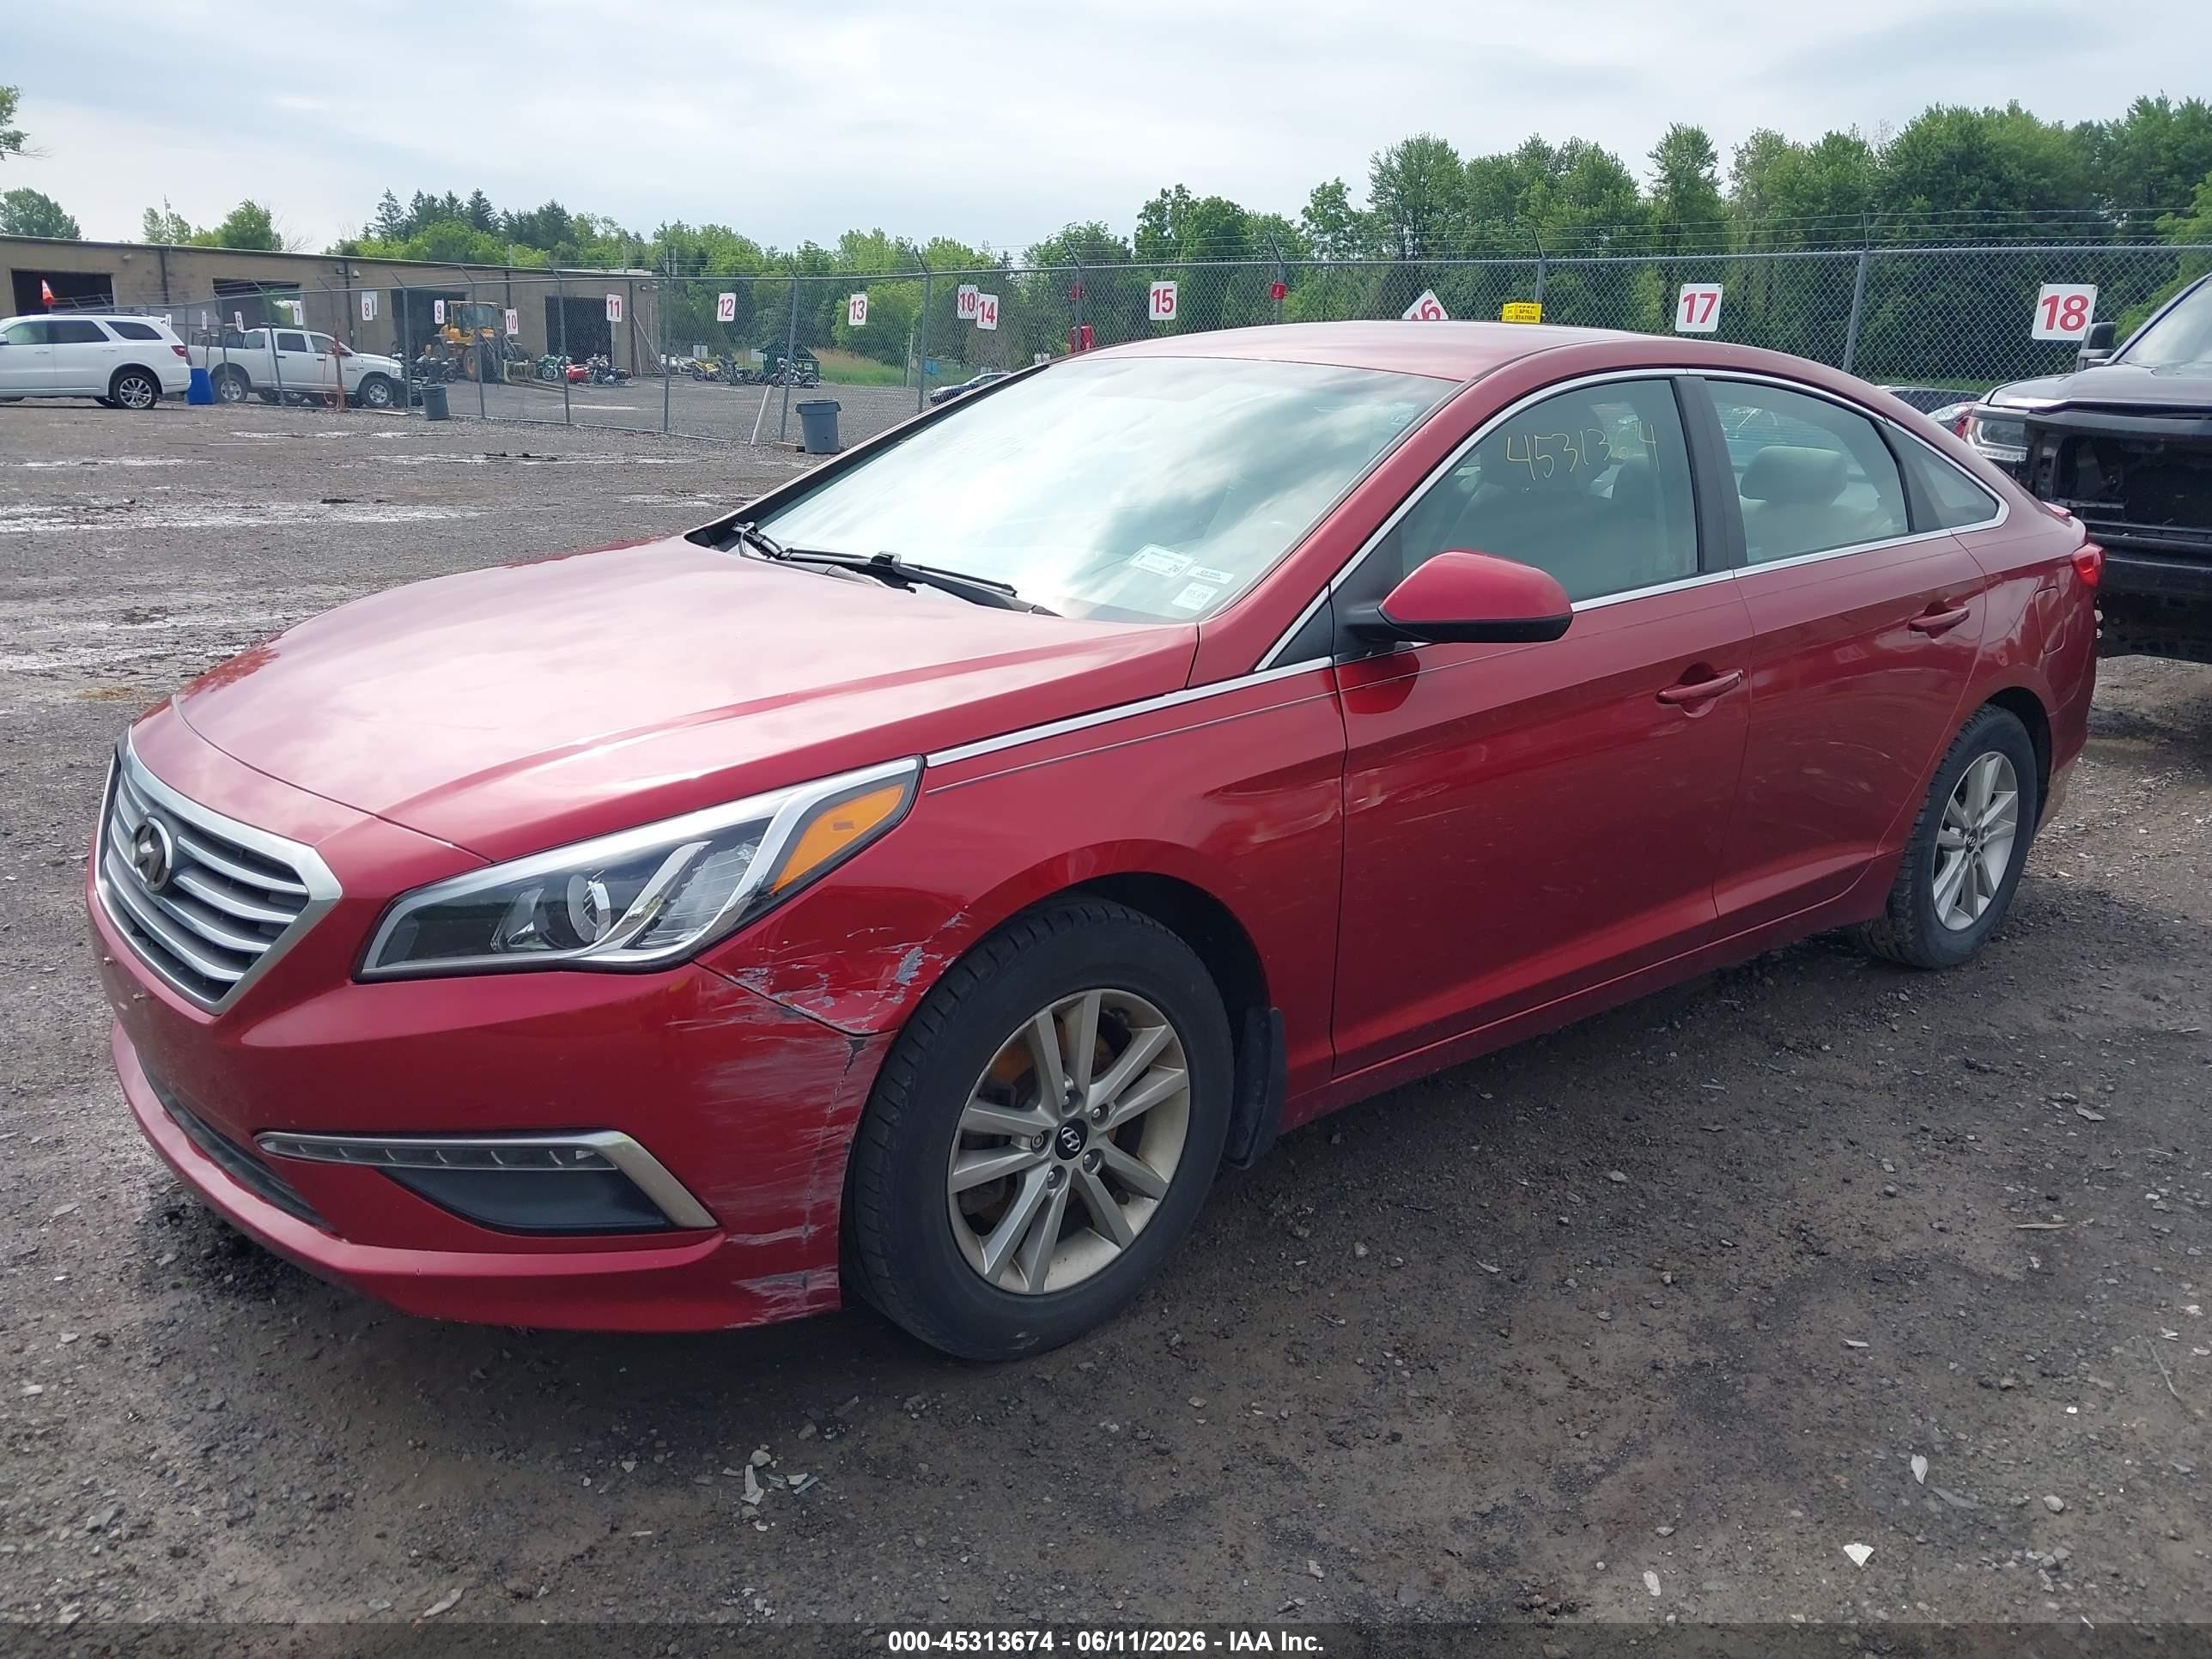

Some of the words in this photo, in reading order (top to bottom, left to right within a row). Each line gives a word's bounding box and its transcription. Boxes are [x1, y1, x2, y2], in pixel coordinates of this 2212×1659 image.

[364, 302, 370, 317] 8
[608, 299, 620, 318] 11
[719, 298, 734, 317] 12
[851, 300, 866, 320] 13
[959, 292, 975, 313] 10
[1152, 288, 1174, 313] 15
[1411, 299, 1441, 320] 6
[1683, 293, 1717, 323] 17
[436, 304, 442, 319] 9
[979, 301, 996, 324] 14
[2041, 295, 2089, 331] 18
[507, 314, 517, 330] 10
